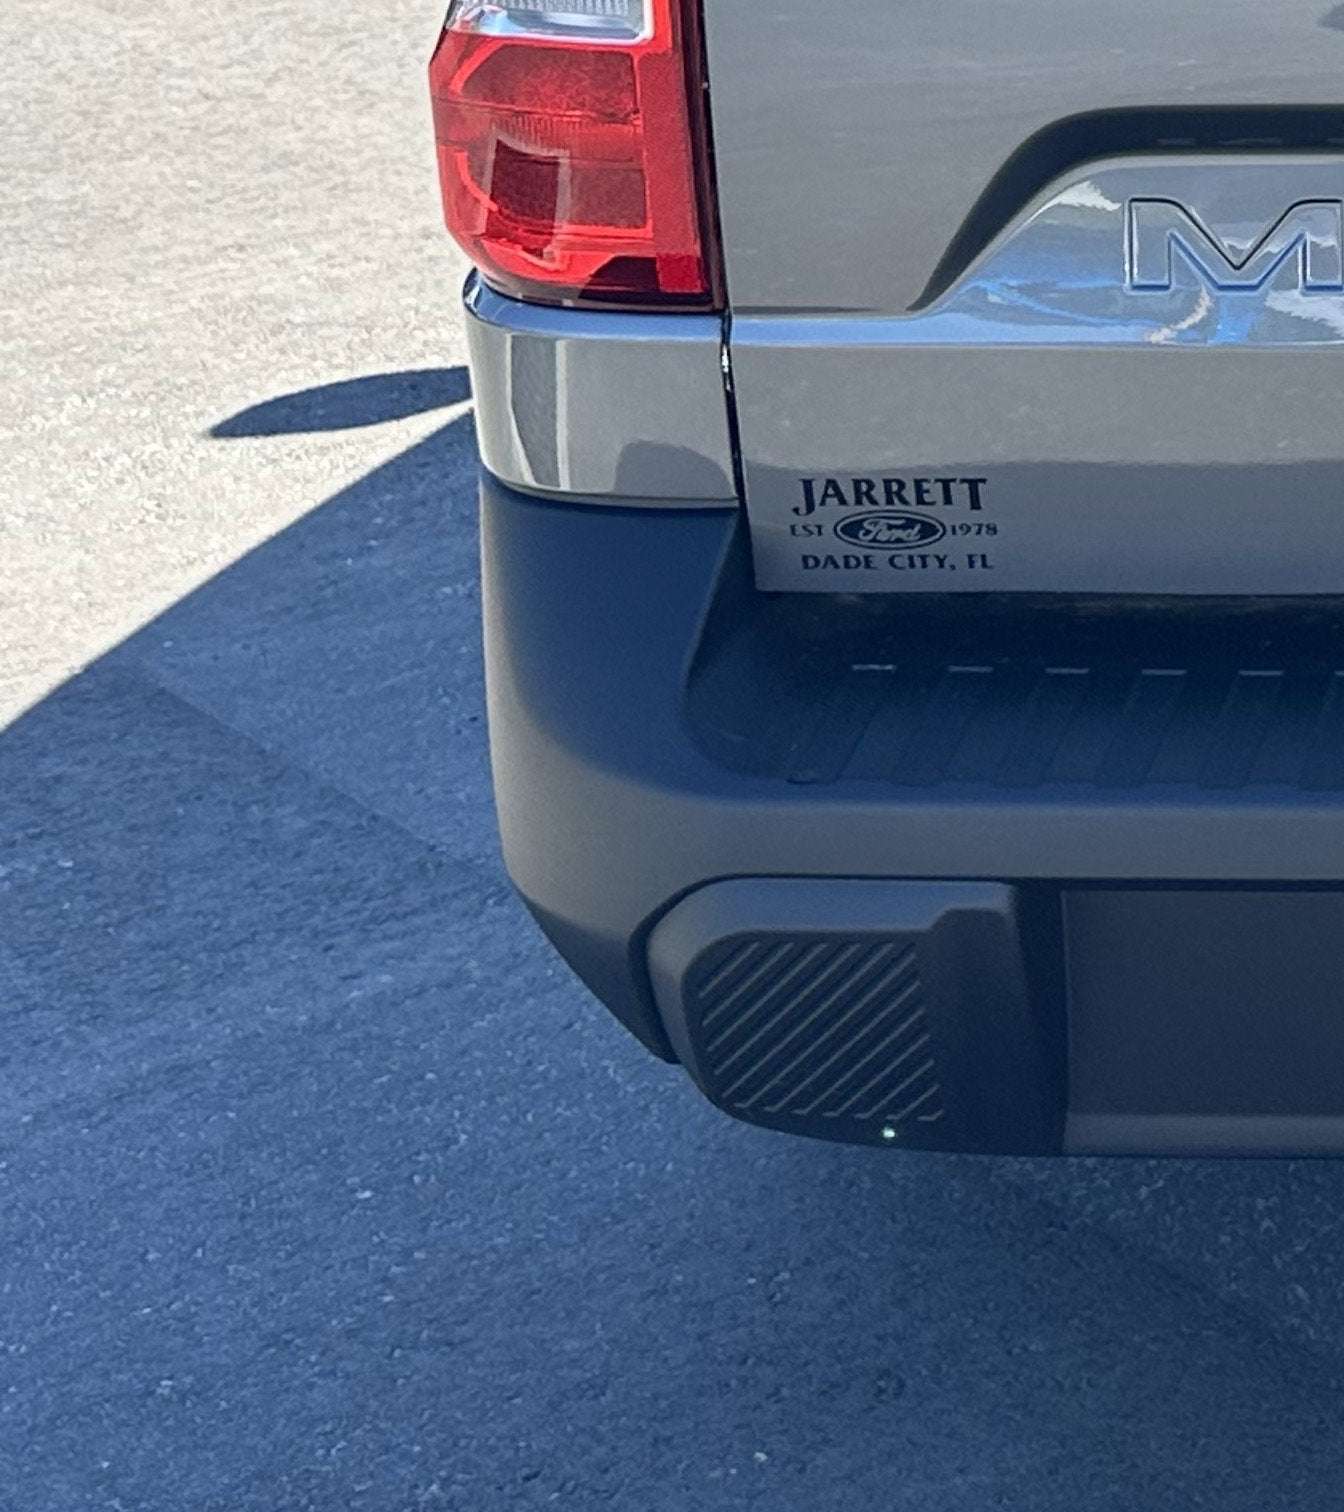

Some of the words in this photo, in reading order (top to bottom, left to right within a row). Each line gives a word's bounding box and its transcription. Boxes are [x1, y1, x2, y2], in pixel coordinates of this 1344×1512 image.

[792, 478, 987, 516] JARRETT
[790, 524, 824, 537] EST
[857, 518, 923, 543] Ford
[951, 523, 999, 537] 1978
[801, 554, 877, 570] DADE
[887, 554, 956, 571] CITY,
[966, 553, 995, 570] FL
